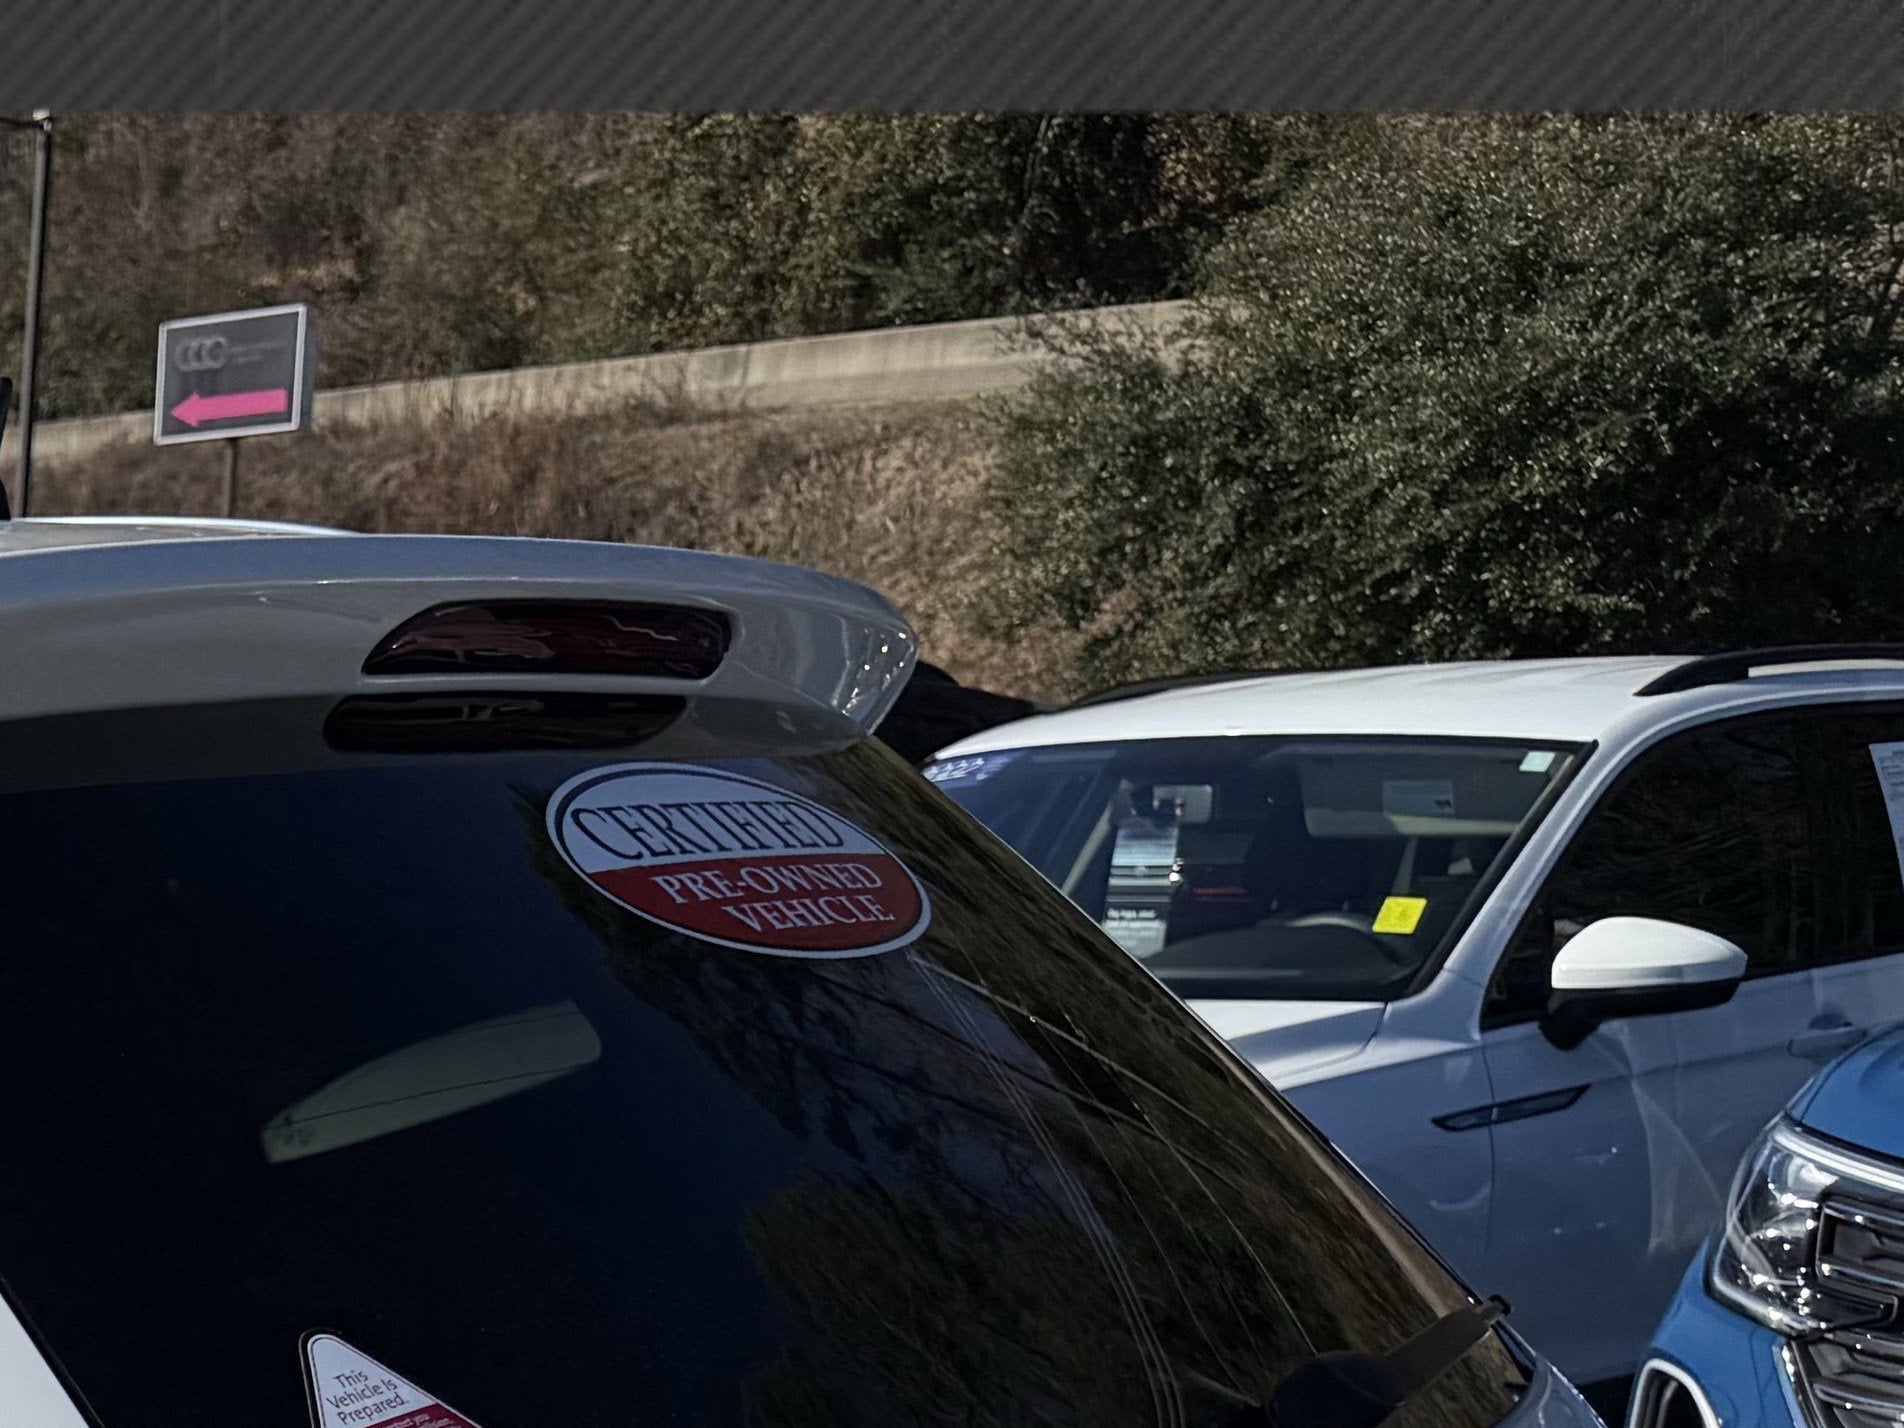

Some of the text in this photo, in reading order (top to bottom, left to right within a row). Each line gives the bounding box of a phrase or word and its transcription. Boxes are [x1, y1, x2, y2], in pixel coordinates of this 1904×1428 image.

[571, 800, 844, 861] CERTIFIED
[651, 862, 882, 905] PRE-OWNED
[722, 894, 896, 932] VEHICLE
[326, 1378, 398, 1409] Vehicle Is
[333, 1370, 368, 1389] This
